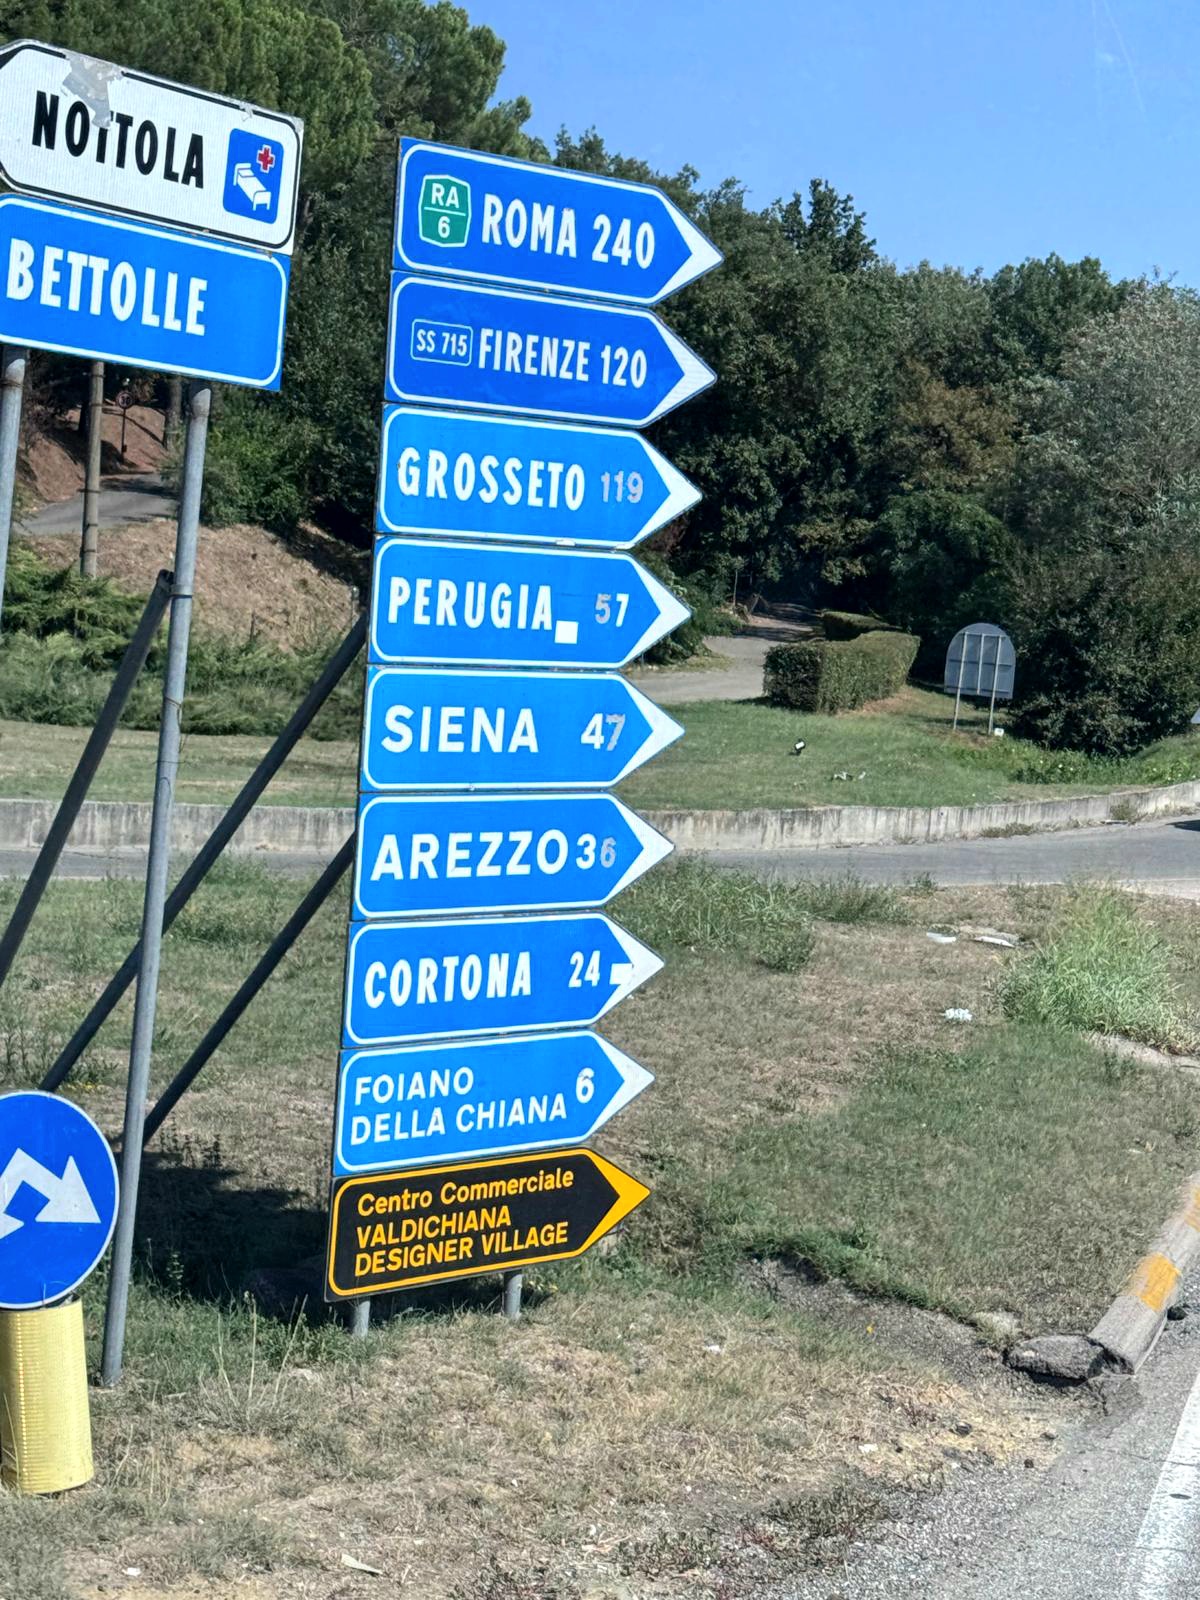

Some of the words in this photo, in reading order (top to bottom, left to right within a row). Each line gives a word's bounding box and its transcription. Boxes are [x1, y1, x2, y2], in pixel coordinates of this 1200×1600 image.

[431, 183, 459, 209] RA
[438, 215, 450, 239] 6
[482, 193, 577, 258] ROMA
[592, 214, 655, 269] 240
[6, 238, 207, 336] BETTOLLE
[416, 328, 436, 353] SS
[441, 332, 468, 357] 715
[478, 328, 590, 381] FIRENZE
[601, 345, 647, 388] 120
[398, 447, 585, 511] GROSSETO
[600, 470, 644, 504] 119
[388, 576, 553, 630] PERUGIA
[594, 593, 629, 627] 57
[381, 704, 539, 753] SIENA
[580, 713, 626, 751] 47
[370, 829, 568, 881] AREZZO
[576, 833, 617, 869] 36
[363, 951, 531, 1008] CORTONA
[568, 950, 601, 987] 24
[354, 1066, 474, 1106] FOIANO
[575, 1067, 595, 1104] 6
[350, 1107, 446, 1146] DELLA
[456, 1093, 567, 1133] CHIANA
[357, 1187, 433, 1217] Centro
[440, 1168, 574, 1205] Commerciale
[355, 1237, 473, 1277] DESIGNER
[482, 1221, 568, 1255] VILLAGE
[356, 1205, 511, 1249] VALDICHIANA
